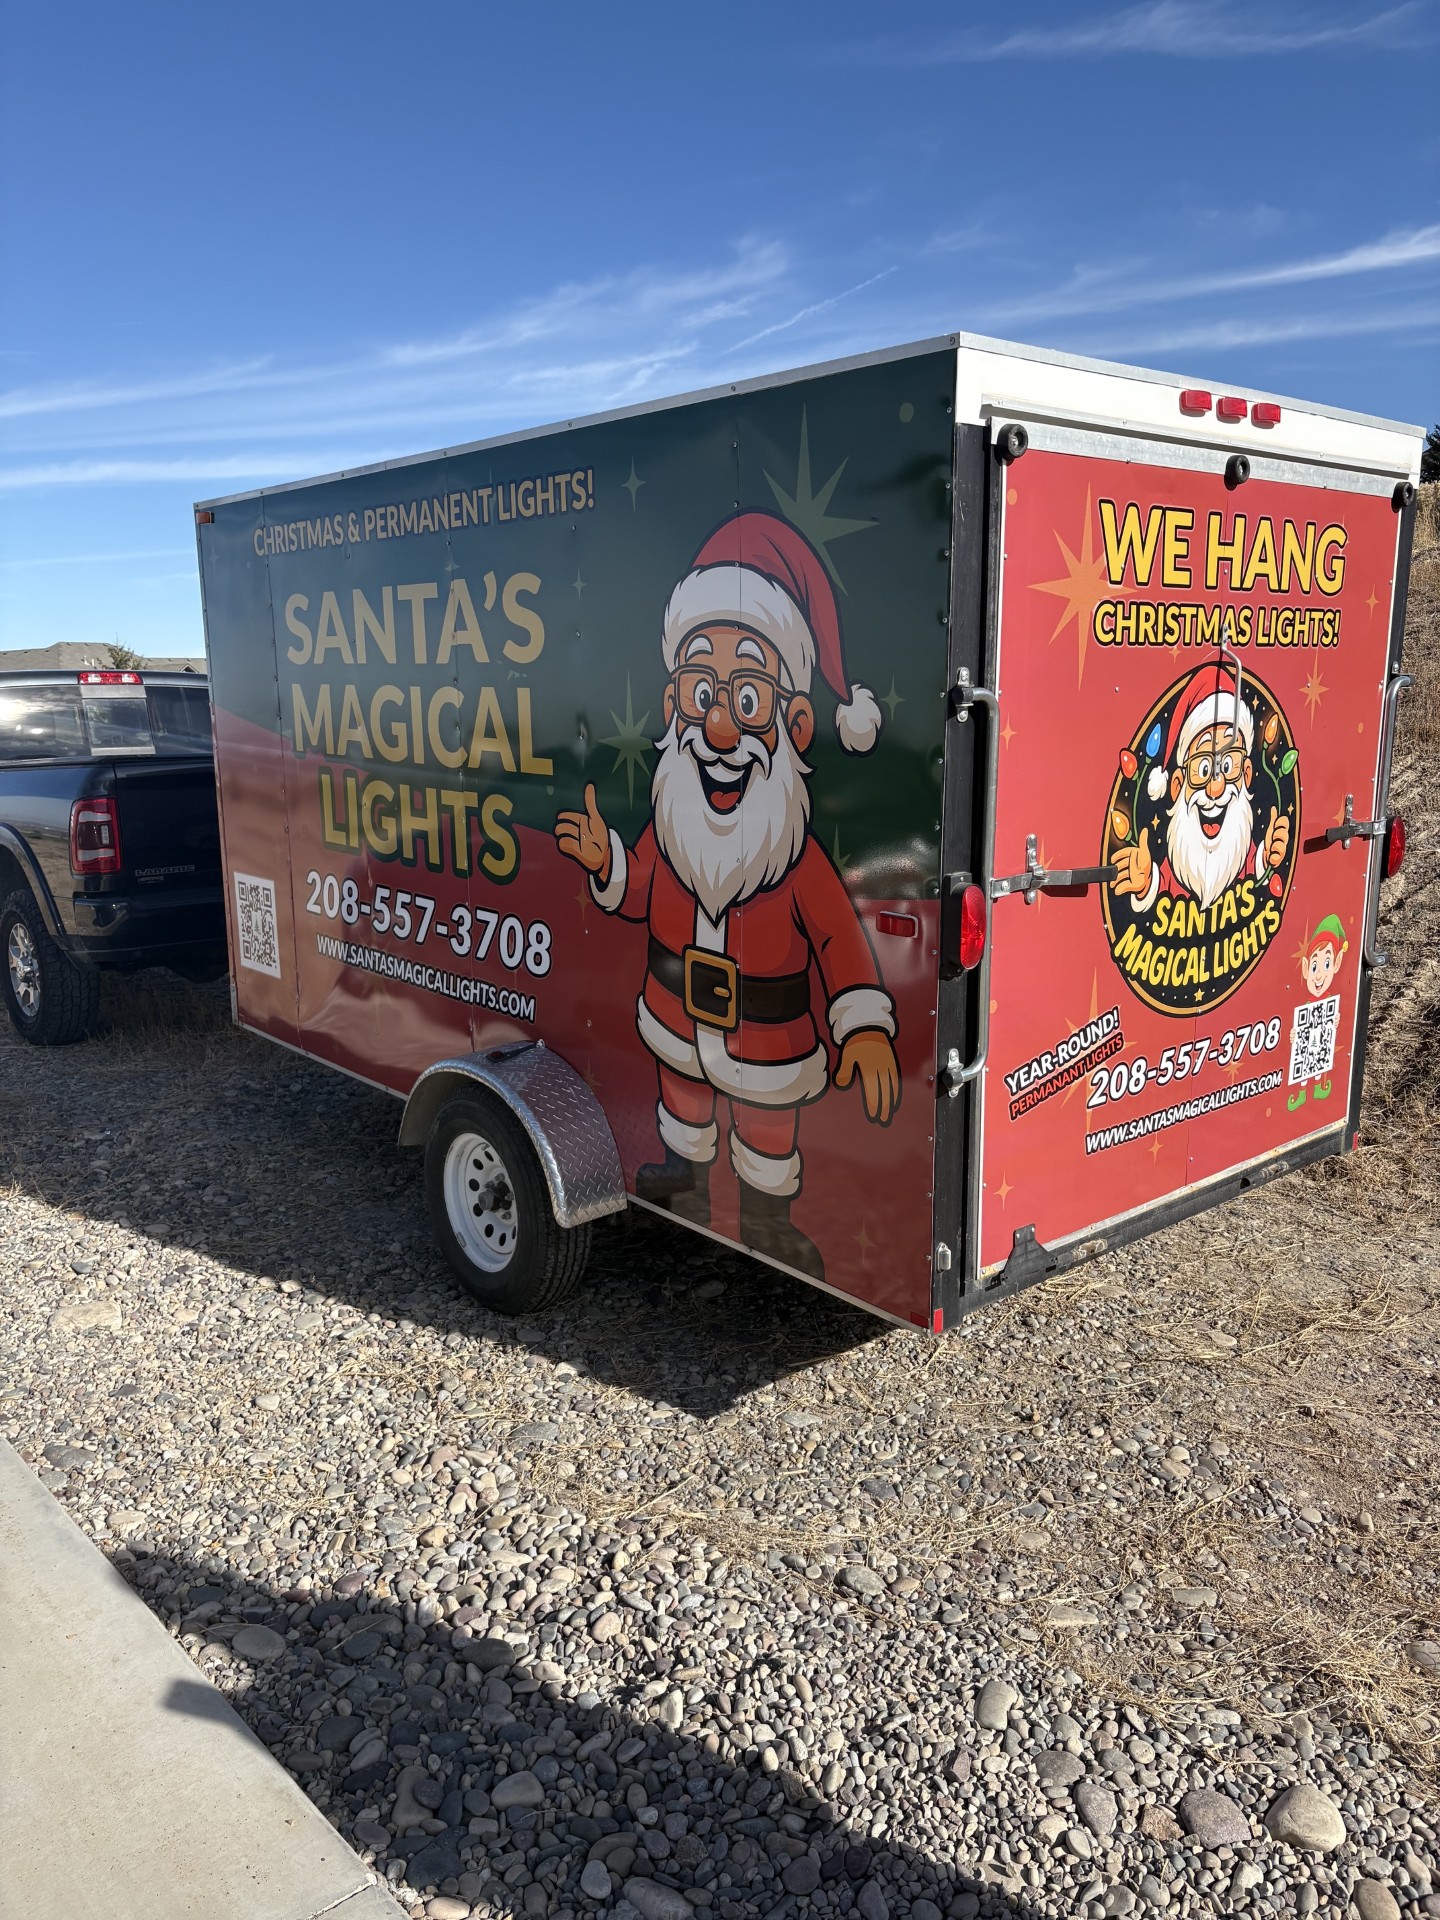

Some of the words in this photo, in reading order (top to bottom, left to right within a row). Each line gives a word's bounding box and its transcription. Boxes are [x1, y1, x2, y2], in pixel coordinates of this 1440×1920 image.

[253, 516, 345, 556] CHRISTMAS
[347, 513, 361, 543] &
[364, 488, 495, 541] PERMANENT
[498, 469, 595, 520] LIGHTS!
[1100, 500, 1194, 588] WE
[1206, 512, 1347, 595] HANG
[285, 571, 545, 665] SANTA'S
[1094, 602, 1251, 646] CHRISTMAS
[1256, 606, 1340, 647] LIGHTS!
[291, 683, 553, 776] MAGICAL
[321, 773, 516, 876] LIGHTS
[305, 870, 552, 976] 208-557-3708
[1114, 924, 1210, 987] MAGICAL
[1213, 900, 1280, 978] LIGHTS
[1152, 880, 1256, 938] SANTA'S
[316, 933, 536, 1021] WWW.SANTASMAGICALLIGHTS.COM
[1005, 1007, 1120, 1095] YEAR-ROUND!
[1010, 1063, 1086, 1119] PERMANANT
[1086, 1034, 1124, 1073] LIGHTS
[1087, 1016, 1282, 1107] 208-557-3708
[1086, 1072, 1283, 1154] WWW.SANTASMAGICALLIGHTS.COM
